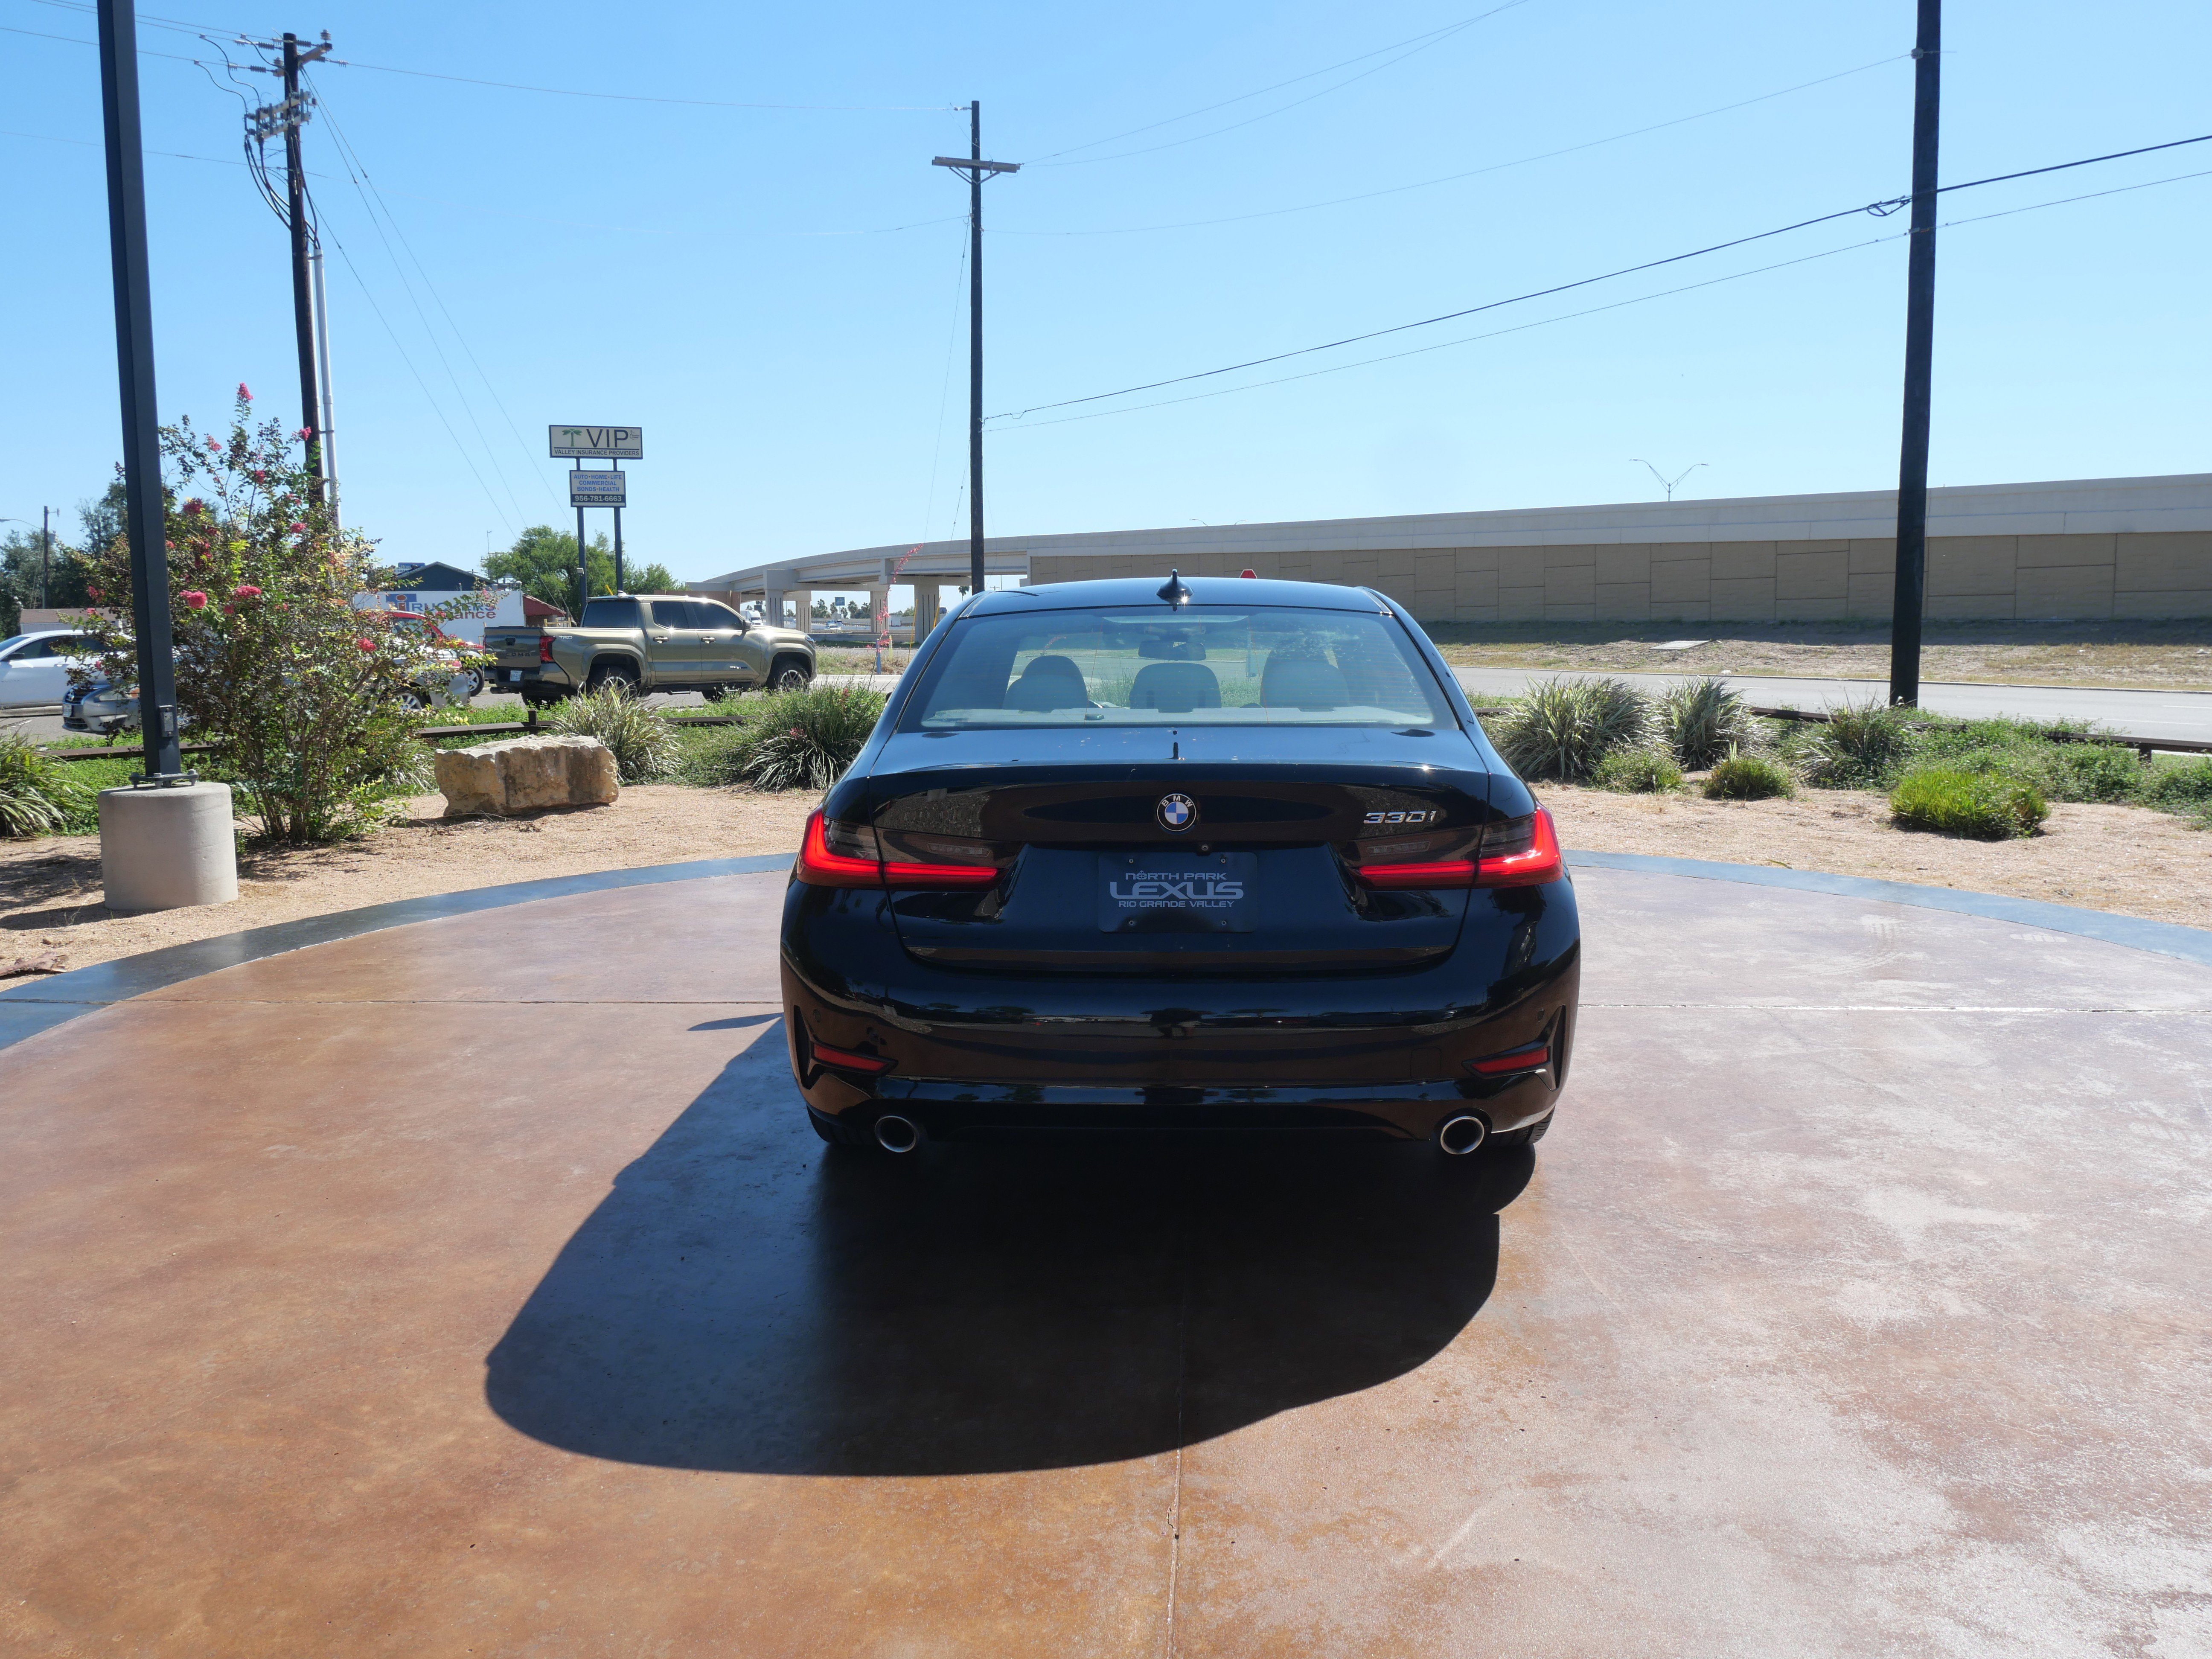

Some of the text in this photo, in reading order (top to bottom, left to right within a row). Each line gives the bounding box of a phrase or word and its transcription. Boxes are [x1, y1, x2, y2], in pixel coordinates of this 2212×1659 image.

[586, 429, 629, 448] VIP
[1161, 795, 1193, 807] BMW
[1363, 811, 1436, 824] 330i
[1125, 871, 1179, 880] NORTH
[1110, 882, 1244, 899] LEXUS
